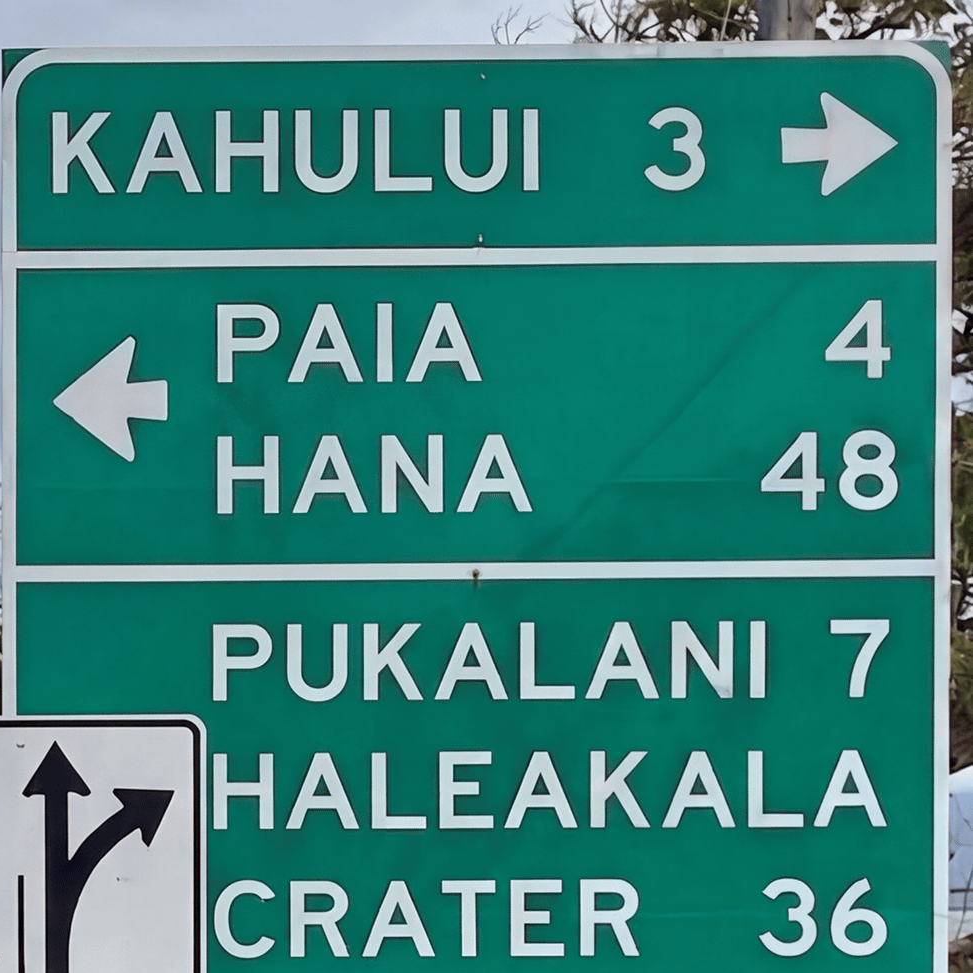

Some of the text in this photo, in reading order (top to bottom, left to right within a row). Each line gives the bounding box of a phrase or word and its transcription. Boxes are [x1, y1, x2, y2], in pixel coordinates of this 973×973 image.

[51, 107, 706, 195] KAHULUI 3
[217, 299, 891, 383] PAIA 4
[217, 430, 899, 514] HANA 48
[212, 619, 890, 702] PUKALANI 7
[212, 749, 888, 830] HALEAKALA
[213, 877, 889, 959] CRATER 36
